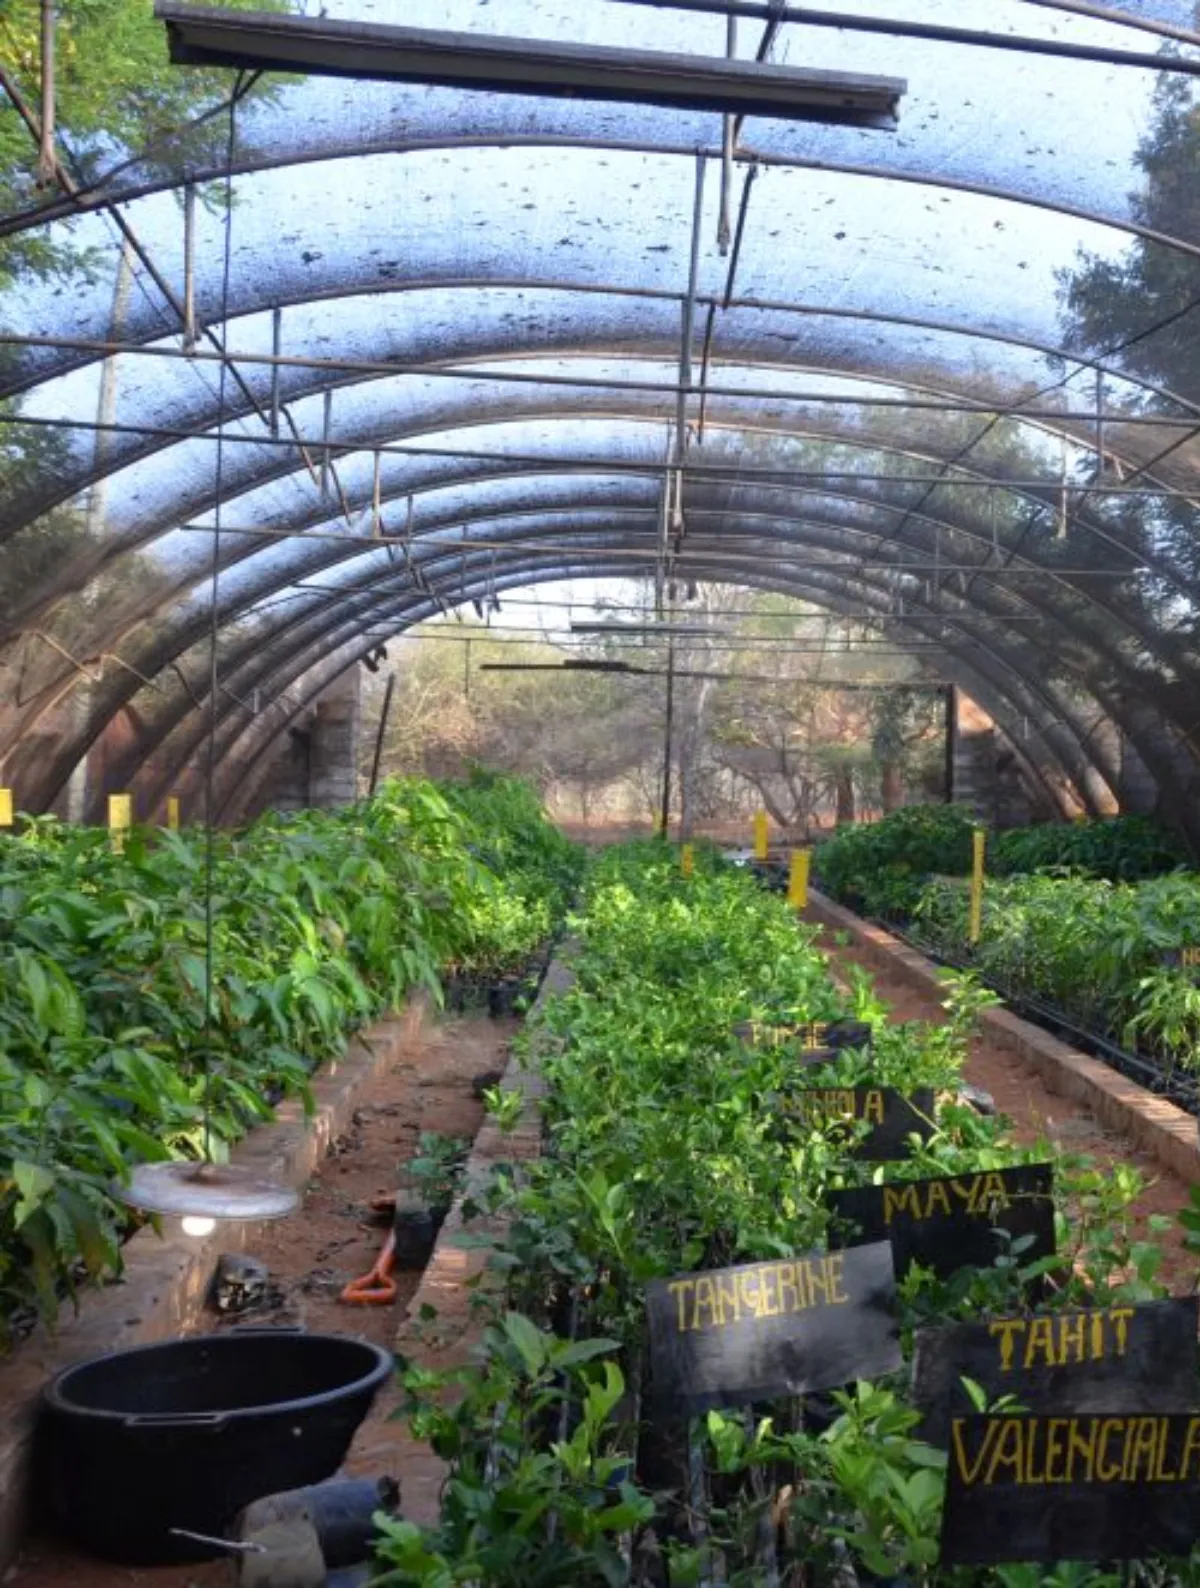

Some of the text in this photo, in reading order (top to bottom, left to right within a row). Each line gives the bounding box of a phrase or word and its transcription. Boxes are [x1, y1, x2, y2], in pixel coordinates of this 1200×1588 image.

[883, 1172, 1012, 1224] MAYA
[668, 1253, 848, 1332] TANGERINE
[988, 1308, 1135, 1371] TAHIT
